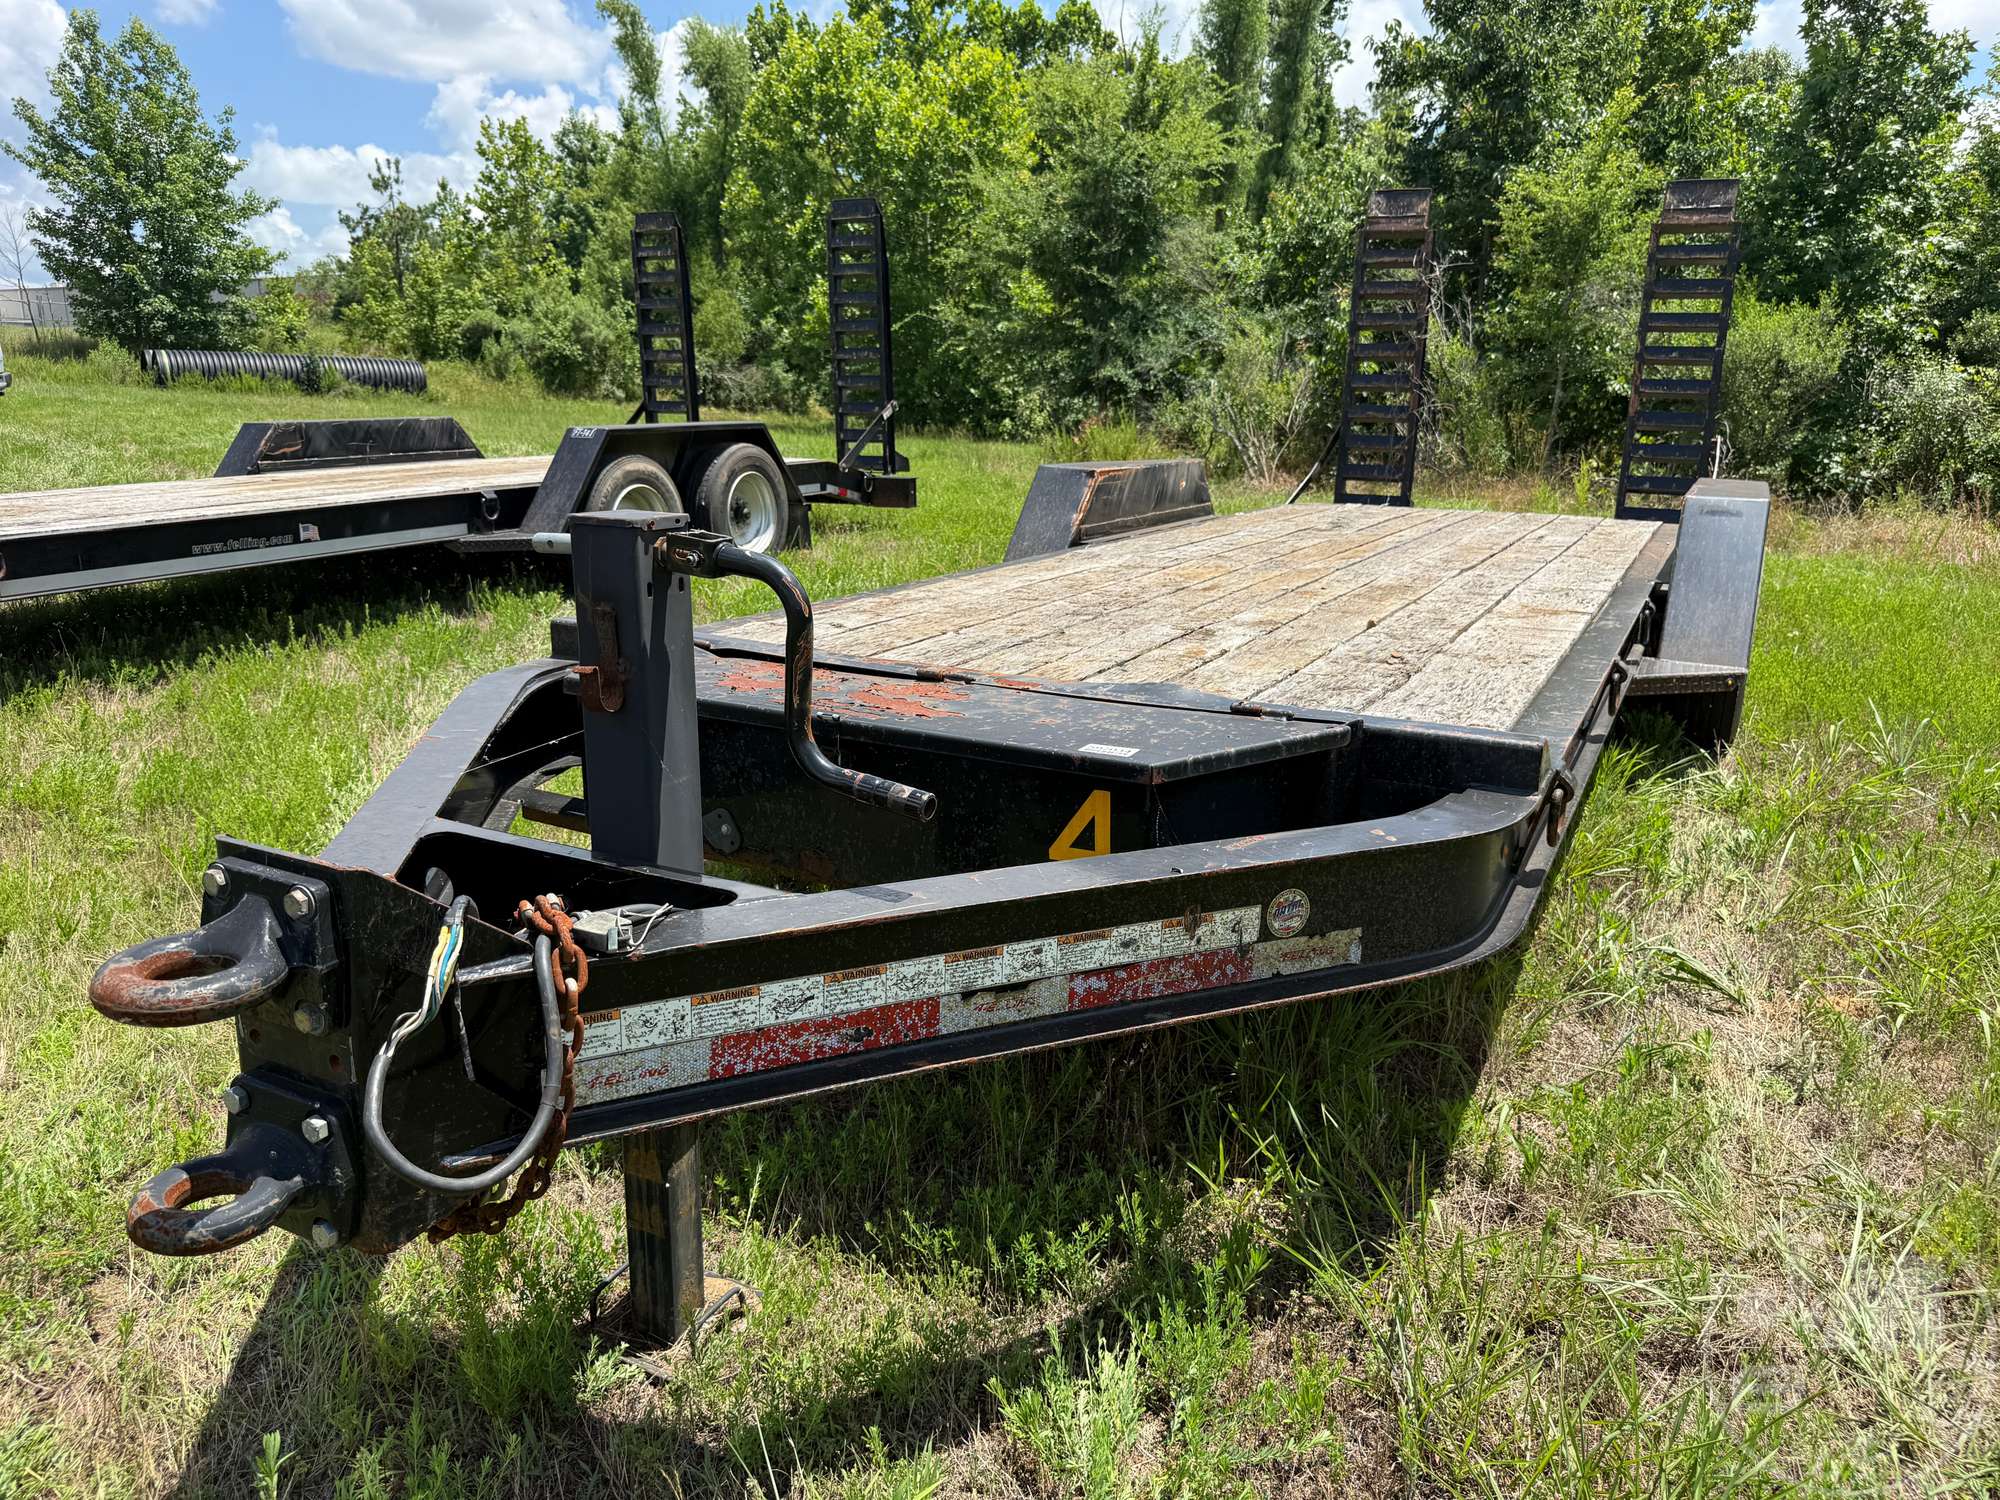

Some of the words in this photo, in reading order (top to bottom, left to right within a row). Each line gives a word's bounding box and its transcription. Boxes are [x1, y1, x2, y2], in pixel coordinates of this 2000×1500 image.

[191, 534, 294, 555] www.felling.com
[1049, 789, 1111, 861] 4
[843, 967, 880, 981] WARNING
[710, 988, 753, 1003] WARNING
[582, 1012, 613, 1024] RNING
